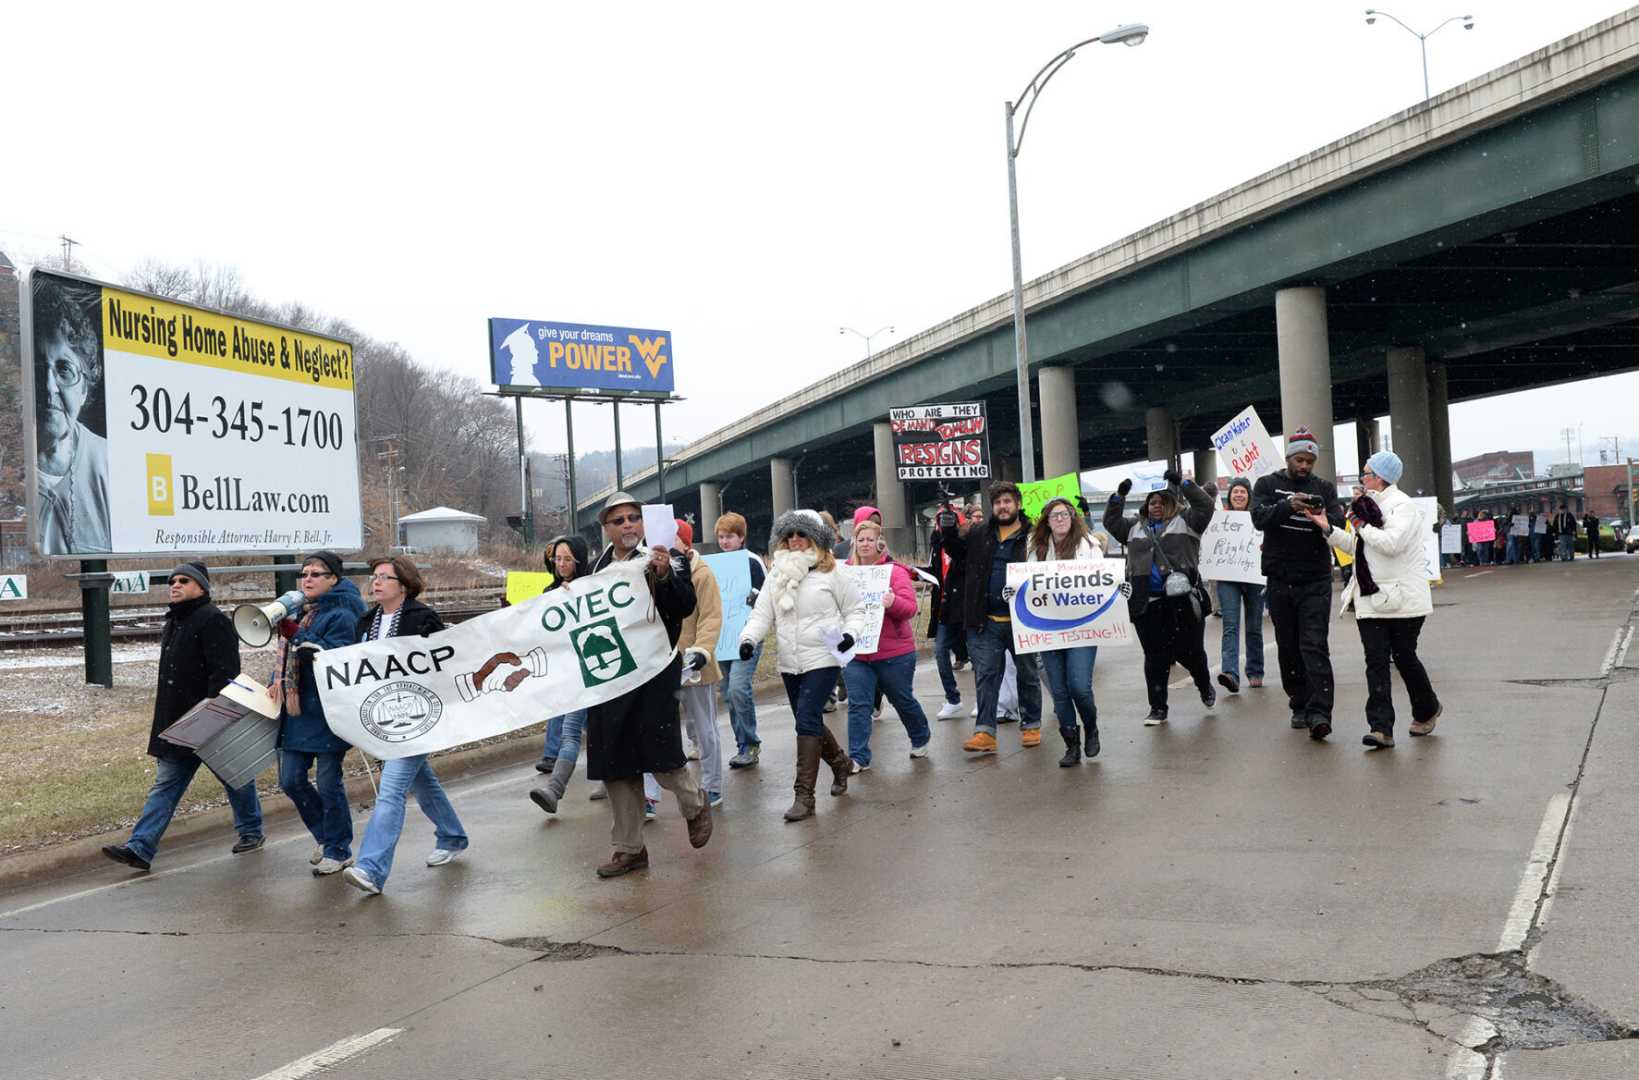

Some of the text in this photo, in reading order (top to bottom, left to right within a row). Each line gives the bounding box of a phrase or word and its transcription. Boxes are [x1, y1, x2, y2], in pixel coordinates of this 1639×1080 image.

[109, 298, 349, 382] Nursing Home Abuse & Neglect?
[538, 326, 613, 342] give your dreams
[549, 342, 632, 372] POWER
[130, 384, 343, 450] 304-345-1700
[893, 405, 978, 419] WHO ARE THEY
[1230, 417, 1251, 436] Water
[899, 440, 980, 465] RESIGNS
[1232, 442, 1260, 473] Right
[900, 466, 987, 477] PROTECTING
[152, 476, 167, 502] B
[180, 474, 330, 513] BellLaw.com
[1023, 484, 1065, 505] STOP
[155, 528, 216, 547] Responsible
[217, 530, 261, 545] Attorney:
[264, 529, 292, 545] Harry
[323, 531, 333, 545] Jr.
[1213, 537, 1255, 559] Right
[1032, 570, 1114, 591] Friends
[541, 581, 635, 633] OVEC
[1032, 593, 1104, 607] of Water
[1018, 623, 1127, 649] HOME TESTING!!!
[326, 645, 455, 690] NAACP
